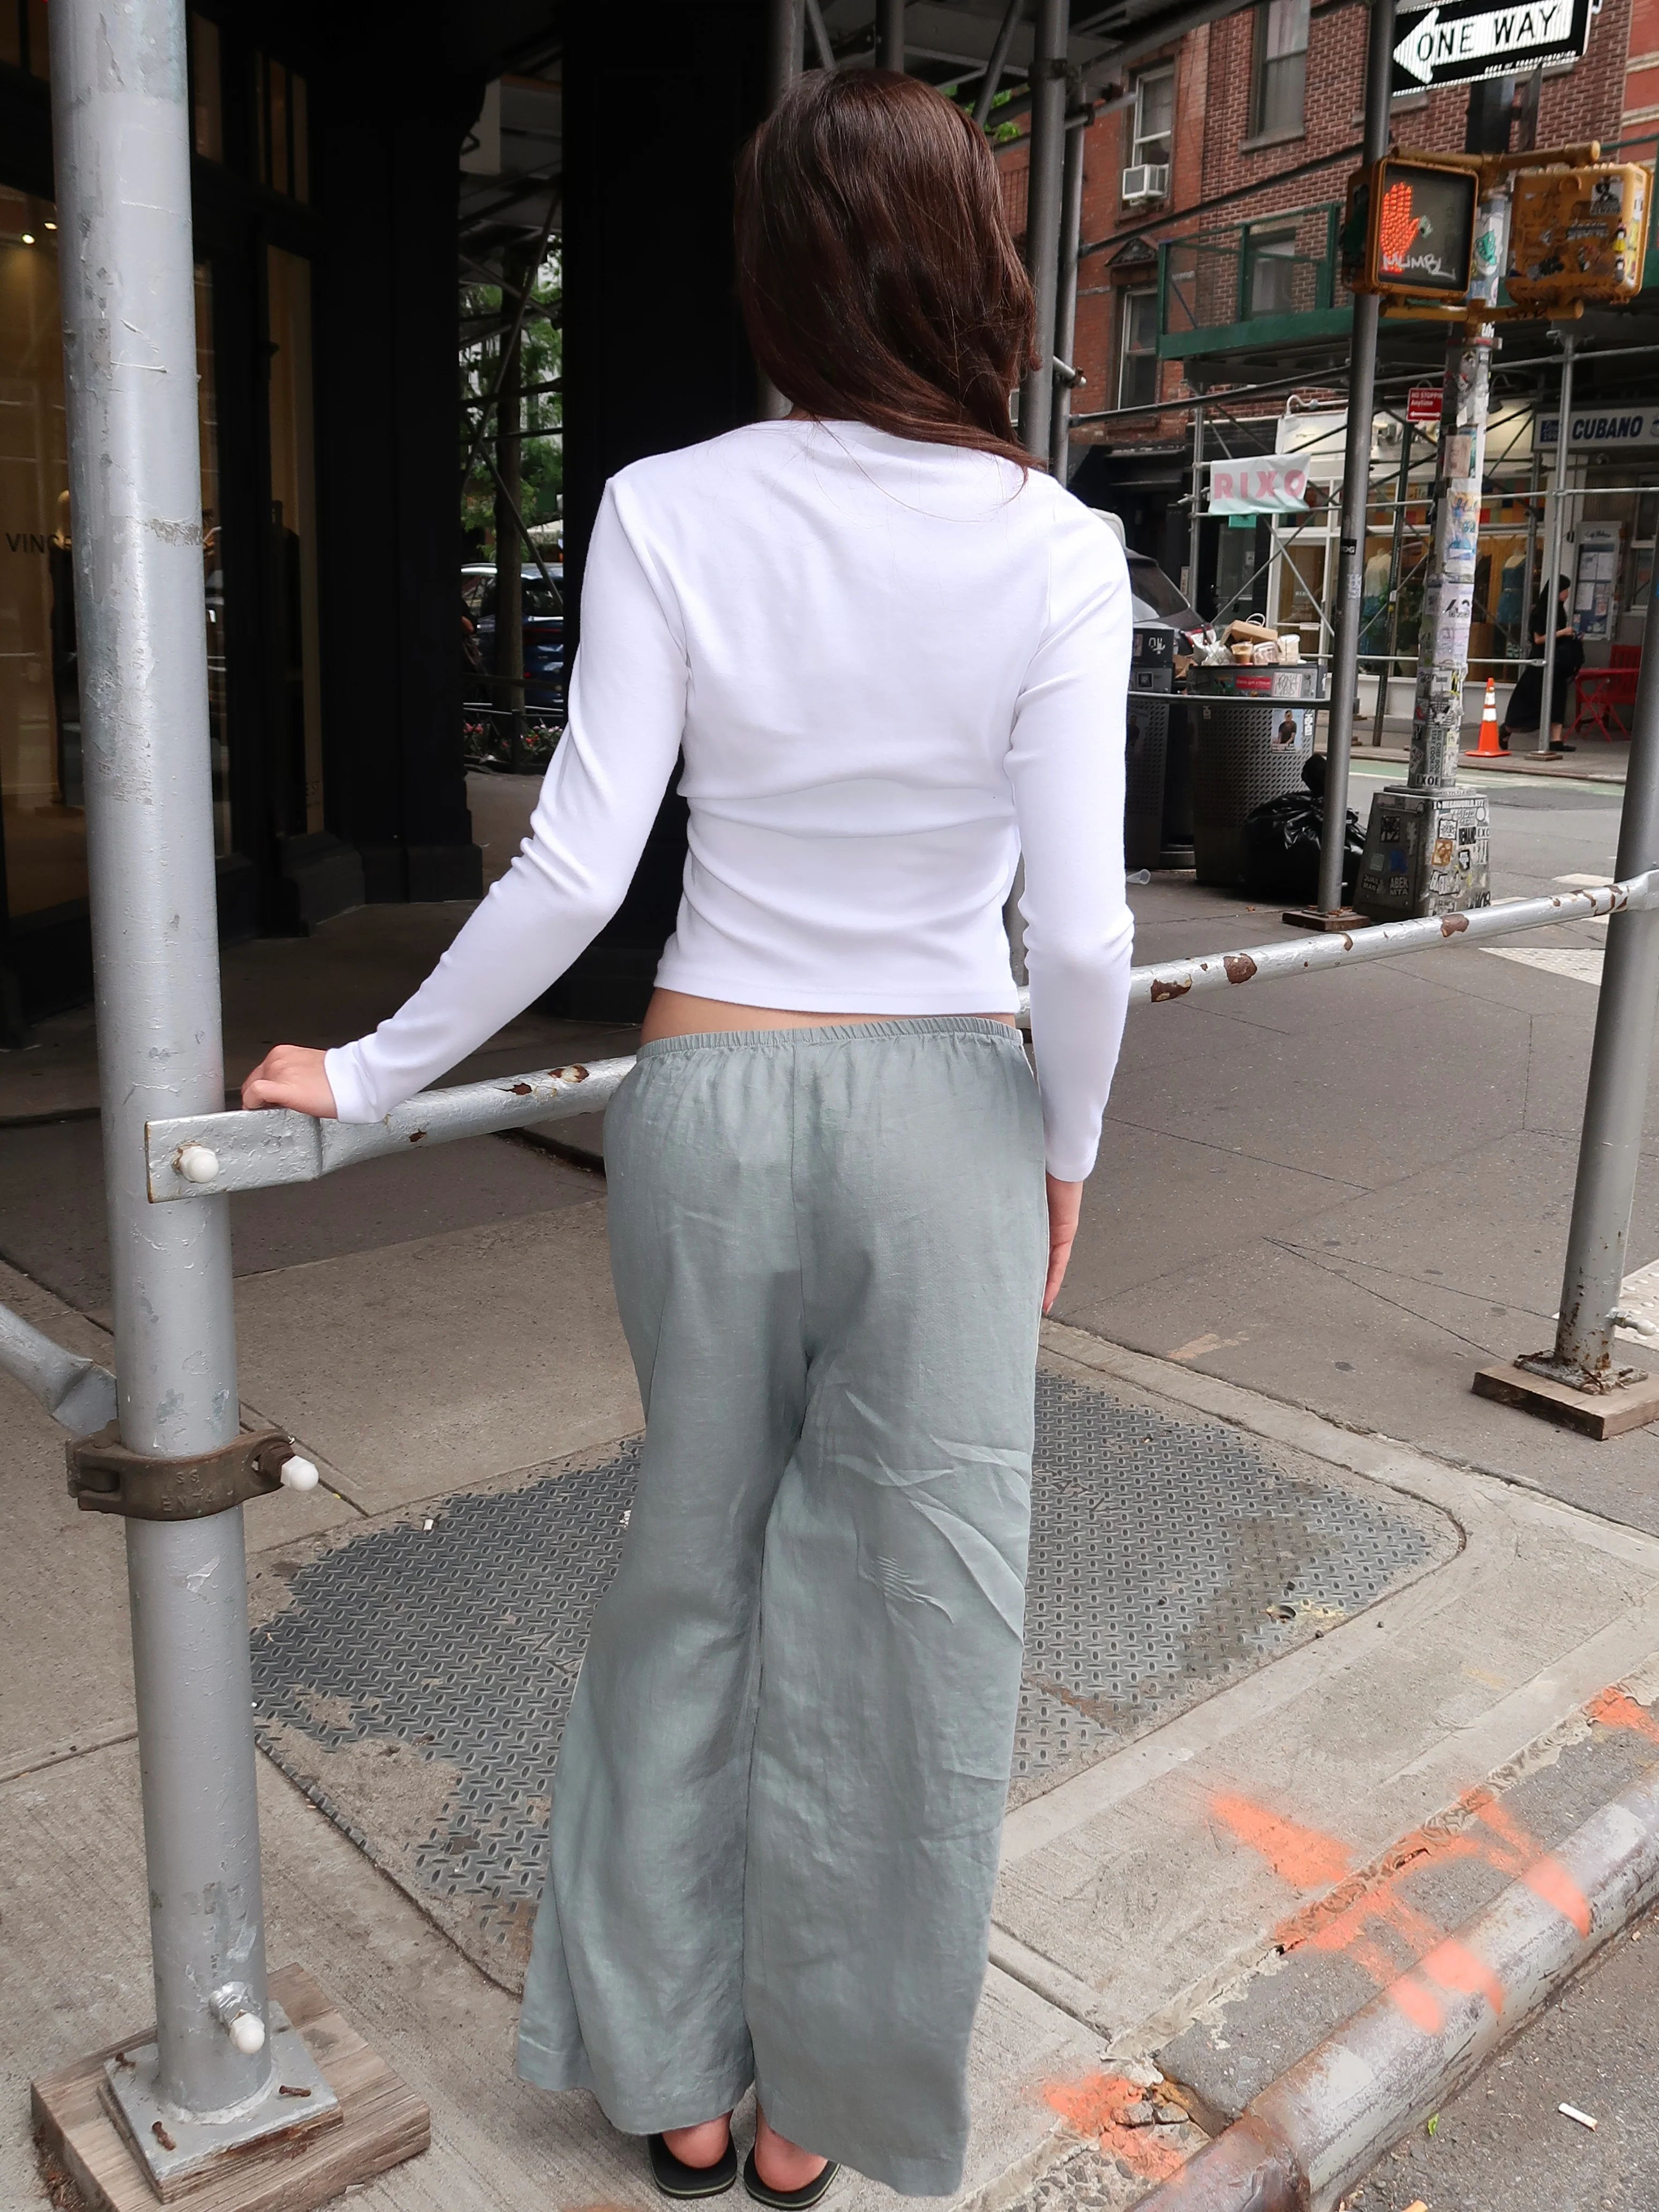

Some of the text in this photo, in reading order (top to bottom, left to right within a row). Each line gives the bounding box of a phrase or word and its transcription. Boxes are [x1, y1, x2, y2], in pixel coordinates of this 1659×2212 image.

[1418, 5, 1558, 61] ONE WAY
[1572, 415, 1644, 440] CUBANO
[1214, 468, 1306, 500] RIXO
